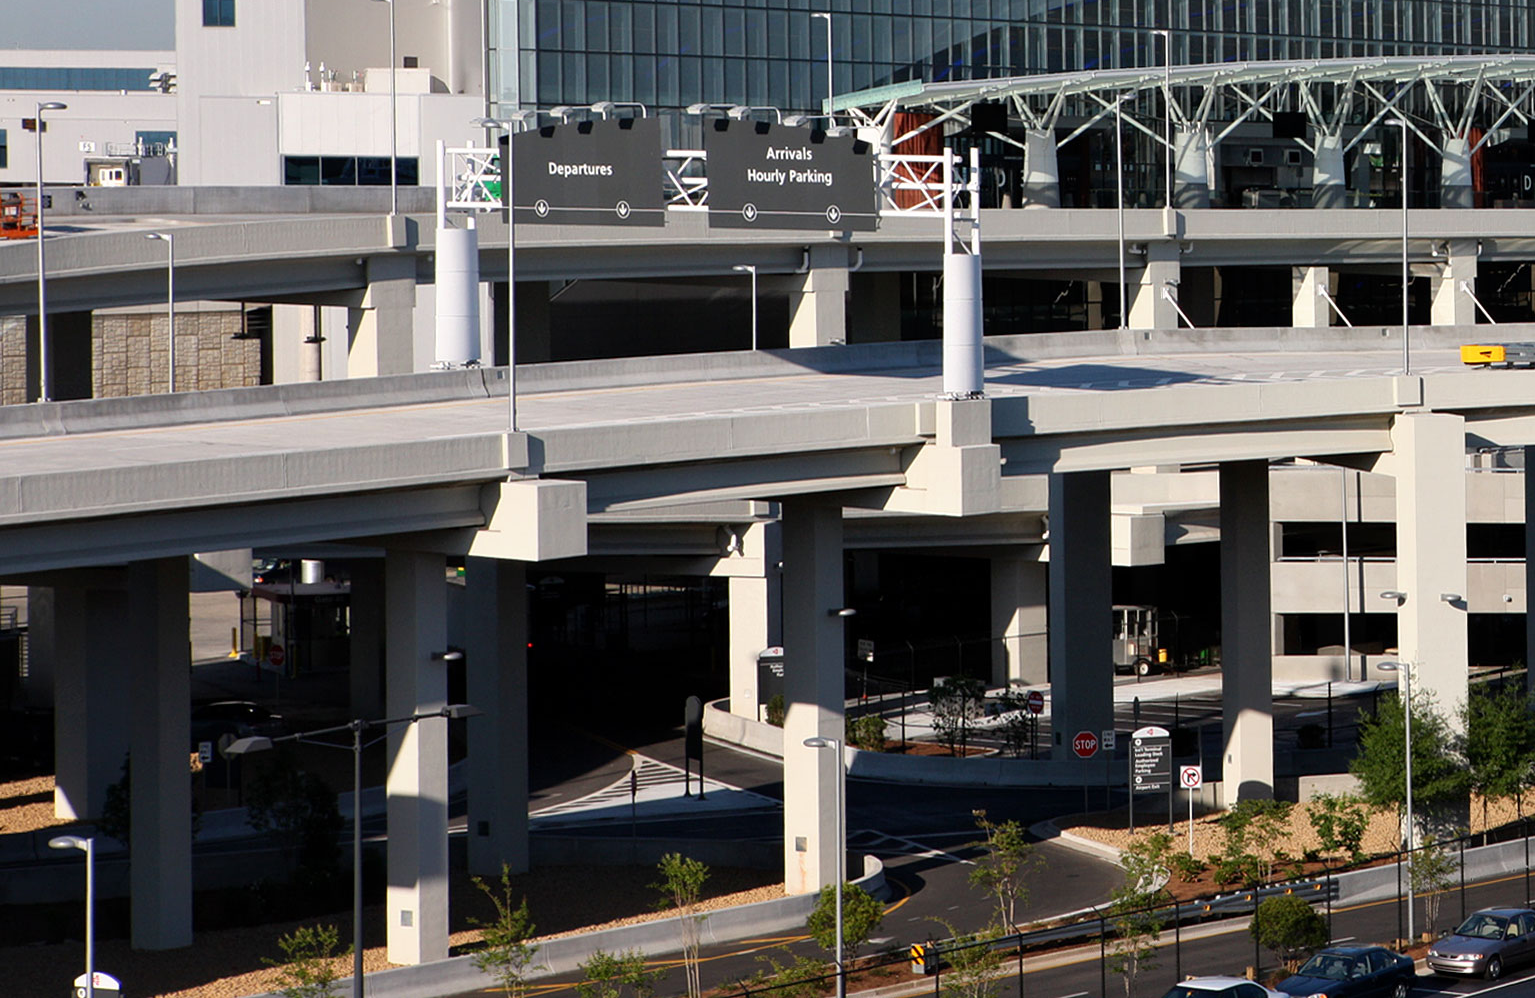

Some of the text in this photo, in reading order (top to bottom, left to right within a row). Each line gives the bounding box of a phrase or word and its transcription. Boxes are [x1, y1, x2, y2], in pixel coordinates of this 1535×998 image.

[766, 146, 813, 161] Arrivals
[548, 162, 613, 177] Departures
[747, 168, 833, 186] Hourly Parking
[1074, 739, 1097, 750] STOP
